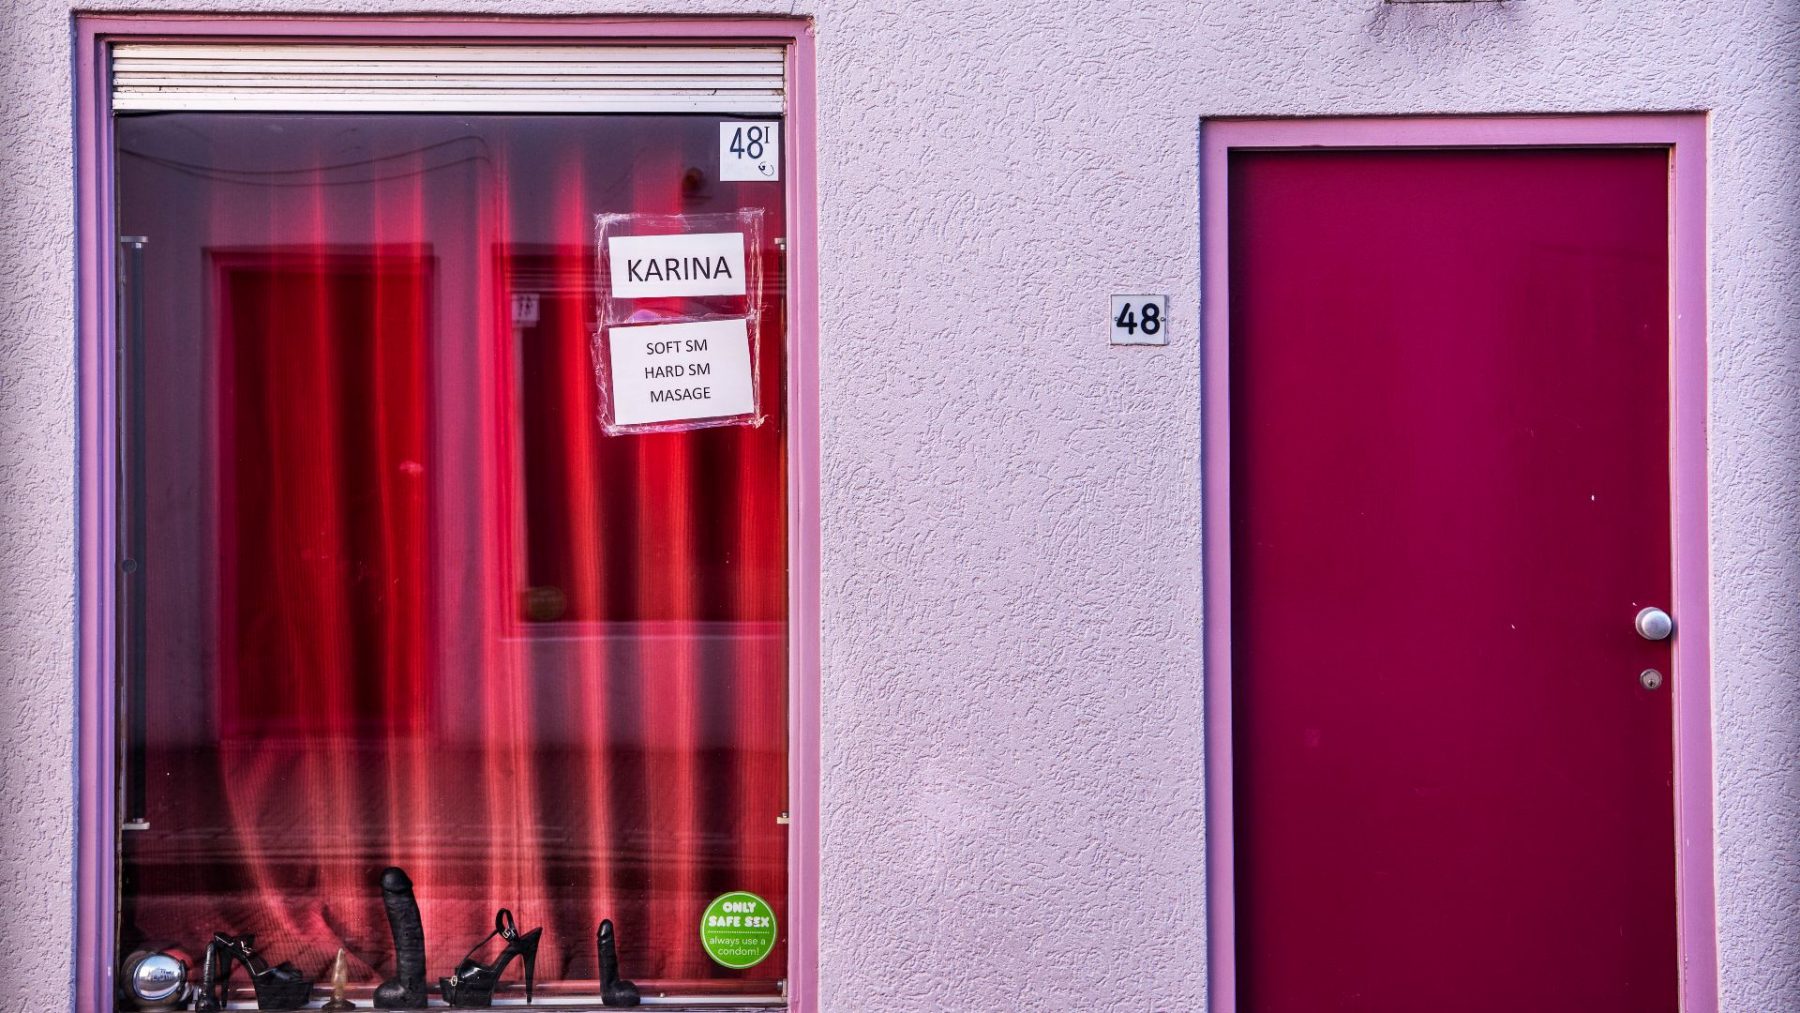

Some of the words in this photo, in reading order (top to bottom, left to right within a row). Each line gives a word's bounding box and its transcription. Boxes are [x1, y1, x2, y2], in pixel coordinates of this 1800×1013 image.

[627, 256, 732, 282] KARINA
[1117, 303, 1160, 335] 48
[646, 340, 682, 355] SOFT
[686, 339, 708, 353] SM
[645, 365, 685, 379] HARD
[688, 363, 711, 376] SM
[650, 387, 711, 403] MASAGE
[723, 902, 756, 913] ONLY
[708, 915, 741, 927] SAFE
[744, 916, 769, 927] SEX
[709, 936, 740, 946] always
[718, 947, 760, 956] condom!
